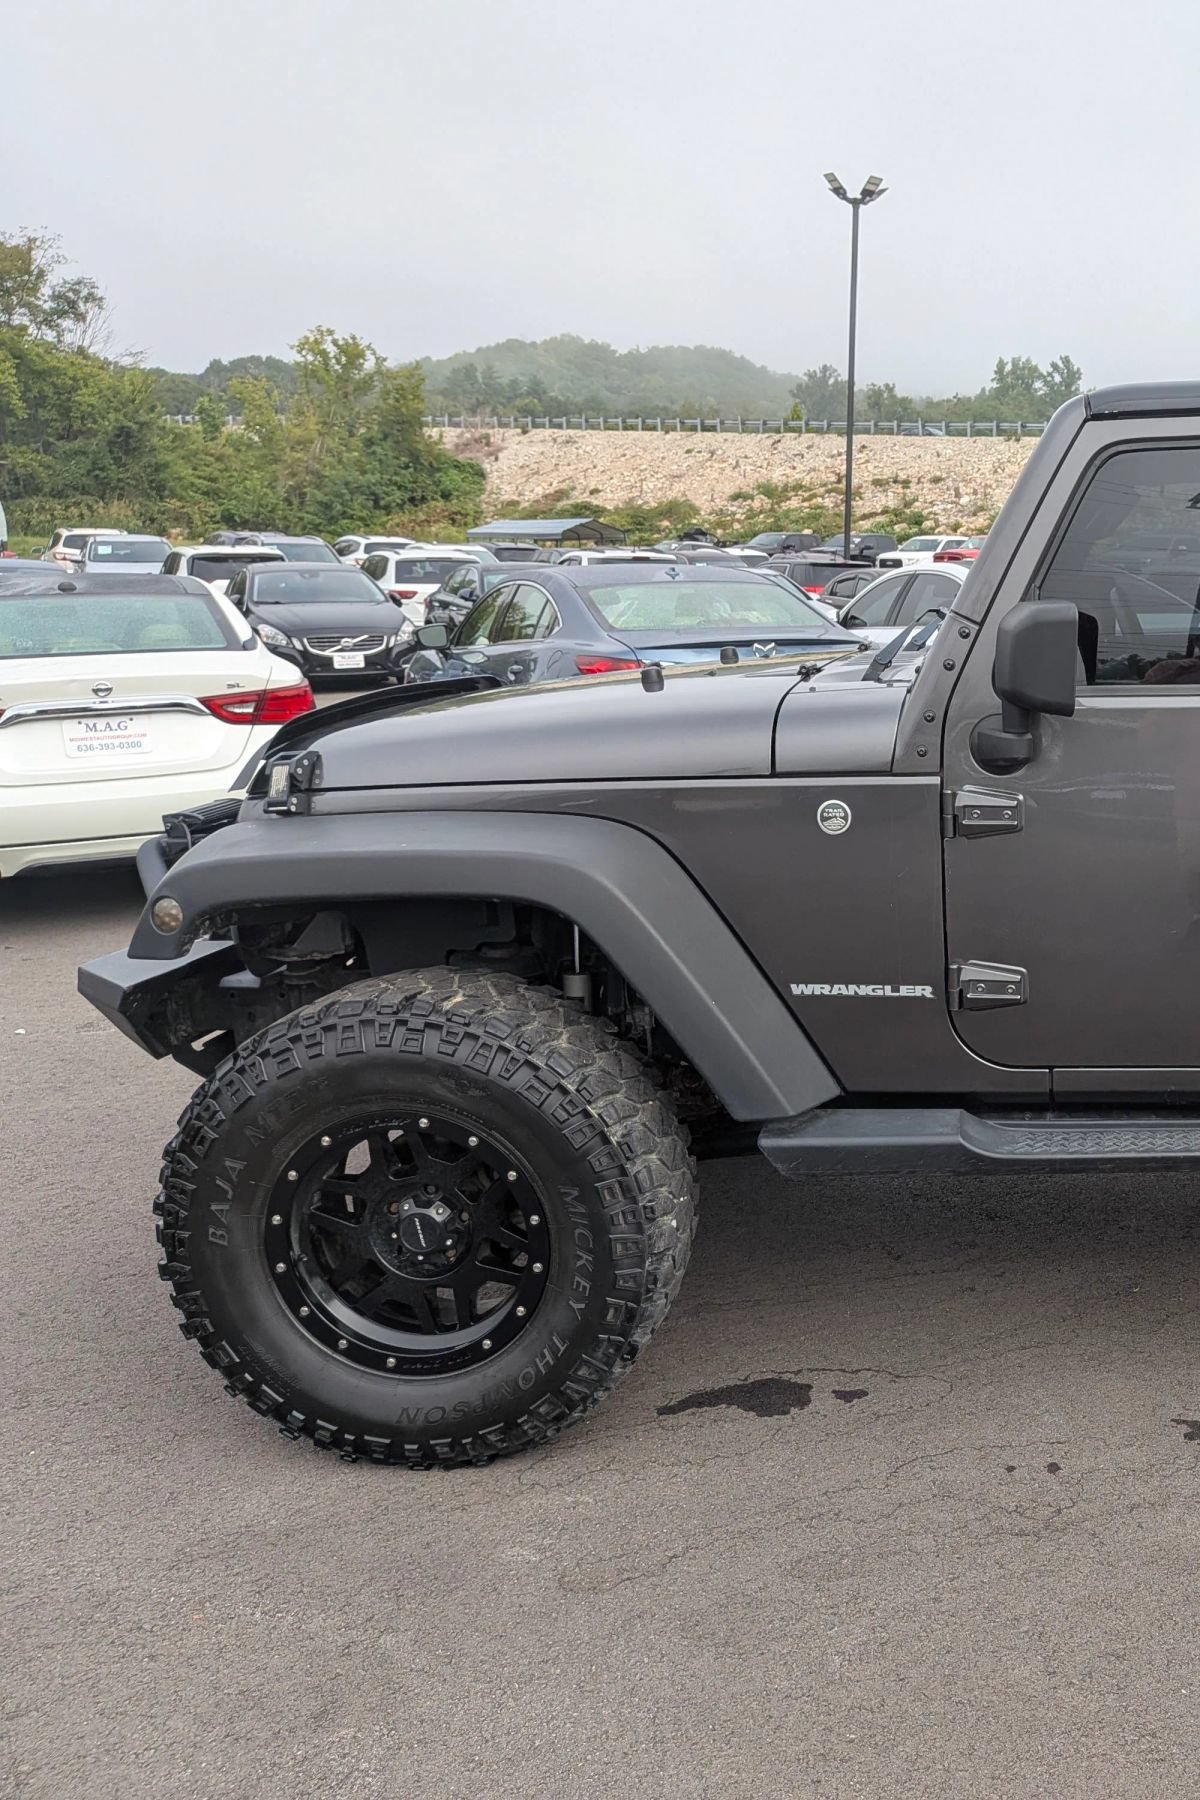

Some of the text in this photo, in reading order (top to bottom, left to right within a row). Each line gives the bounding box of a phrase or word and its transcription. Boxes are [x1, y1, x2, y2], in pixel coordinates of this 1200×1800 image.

[77, 741, 142, 752] 636-393-0300
[85, 720, 128, 733] M.A.G
[789, 983, 937, 999] WRANGLER
[207, 1157, 249, 1247] BAJA
[557, 1184, 595, 1322] MICKEY
[396, 1332, 570, 1426] THOMPSON
